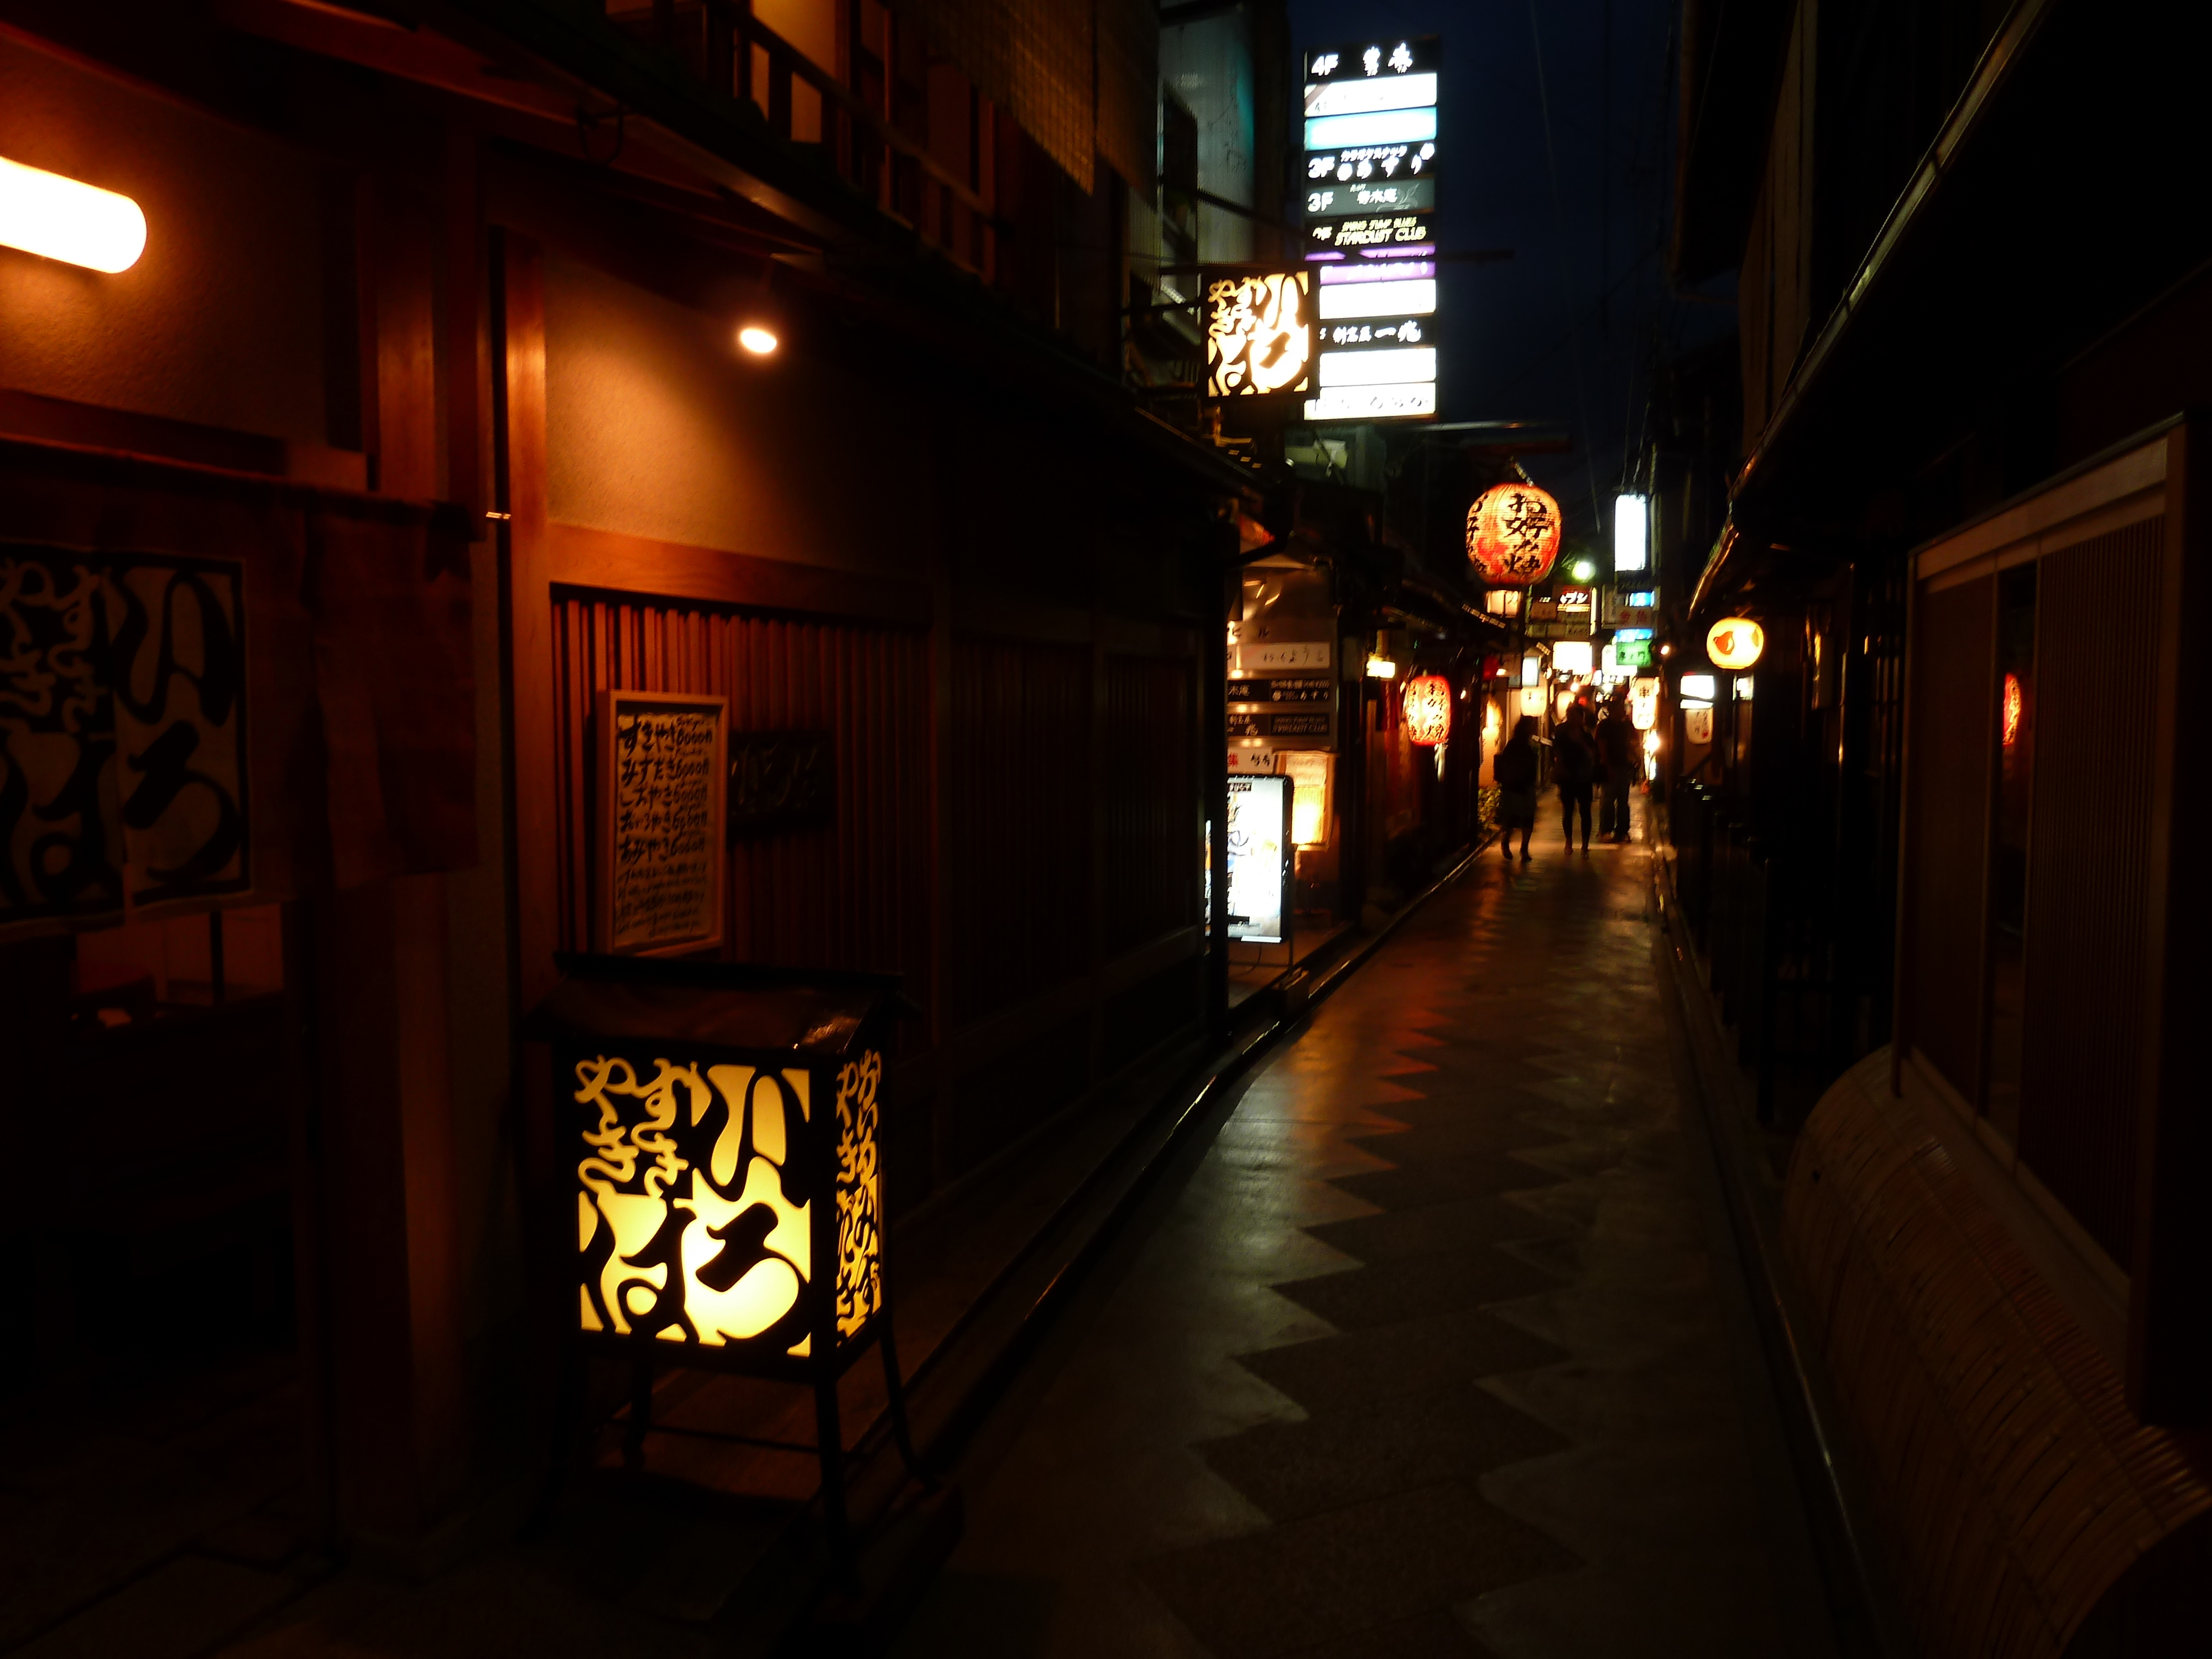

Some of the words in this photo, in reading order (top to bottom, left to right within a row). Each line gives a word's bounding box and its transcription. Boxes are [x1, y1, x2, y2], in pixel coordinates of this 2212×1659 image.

[1311, 54, 1338, 76] 4F
[1308, 157, 1334, 178] 3F
[1308, 191, 1333, 212] 3F
[1334, 228, 1394, 246] STARDUST
[1395, 226, 1426, 241] CLUB
